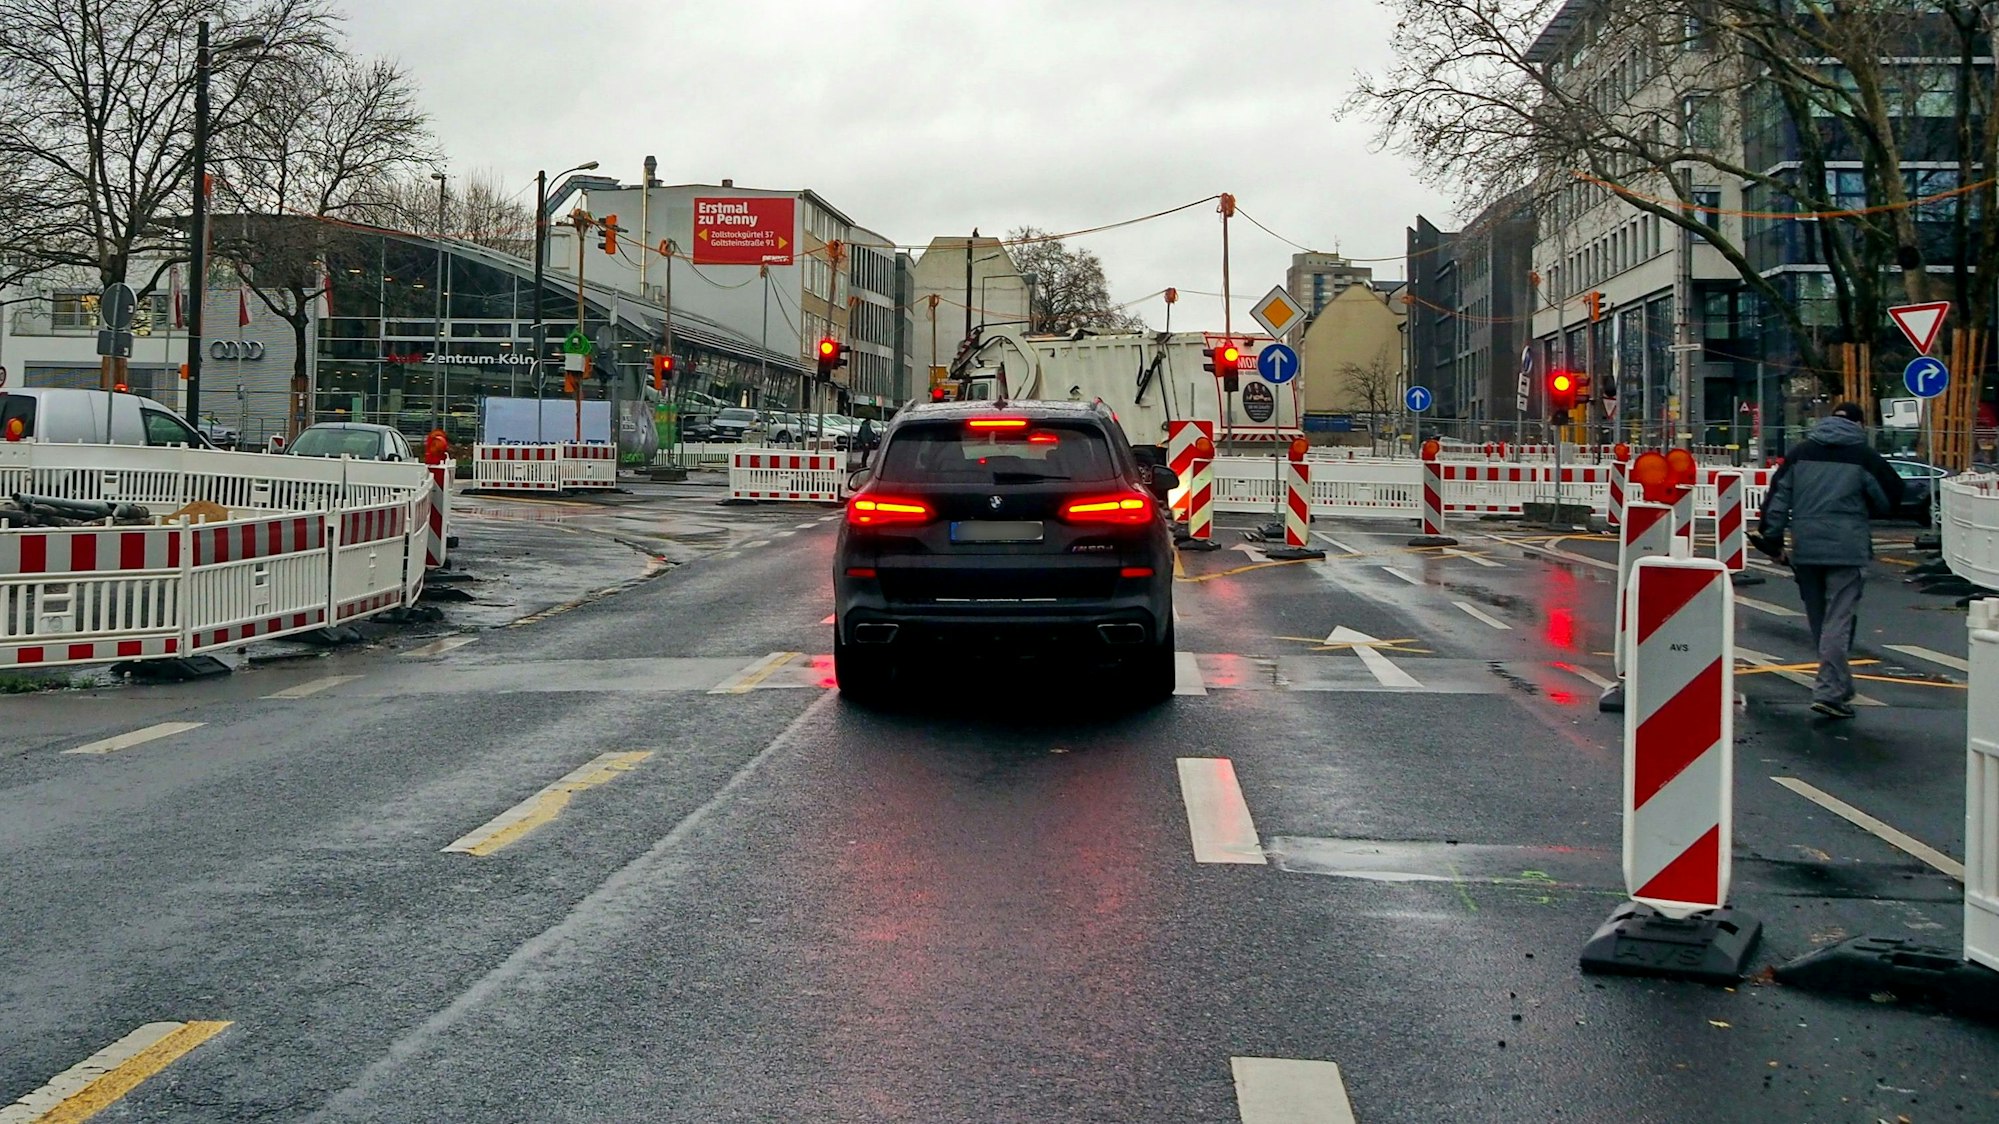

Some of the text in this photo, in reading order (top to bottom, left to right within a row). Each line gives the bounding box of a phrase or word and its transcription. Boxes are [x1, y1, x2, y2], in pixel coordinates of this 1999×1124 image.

[698, 202, 748, 214] Erstmal
[698, 214, 758, 227] zu Penny
[711, 231, 763, 239] Zollstockgürtel
[711, 239, 774, 247] Goltsteinstraße 91
[426, 352, 494, 365] Zentrum
[499, 353, 535, 365] Köln
[1669, 643, 1689, 652] AVS
